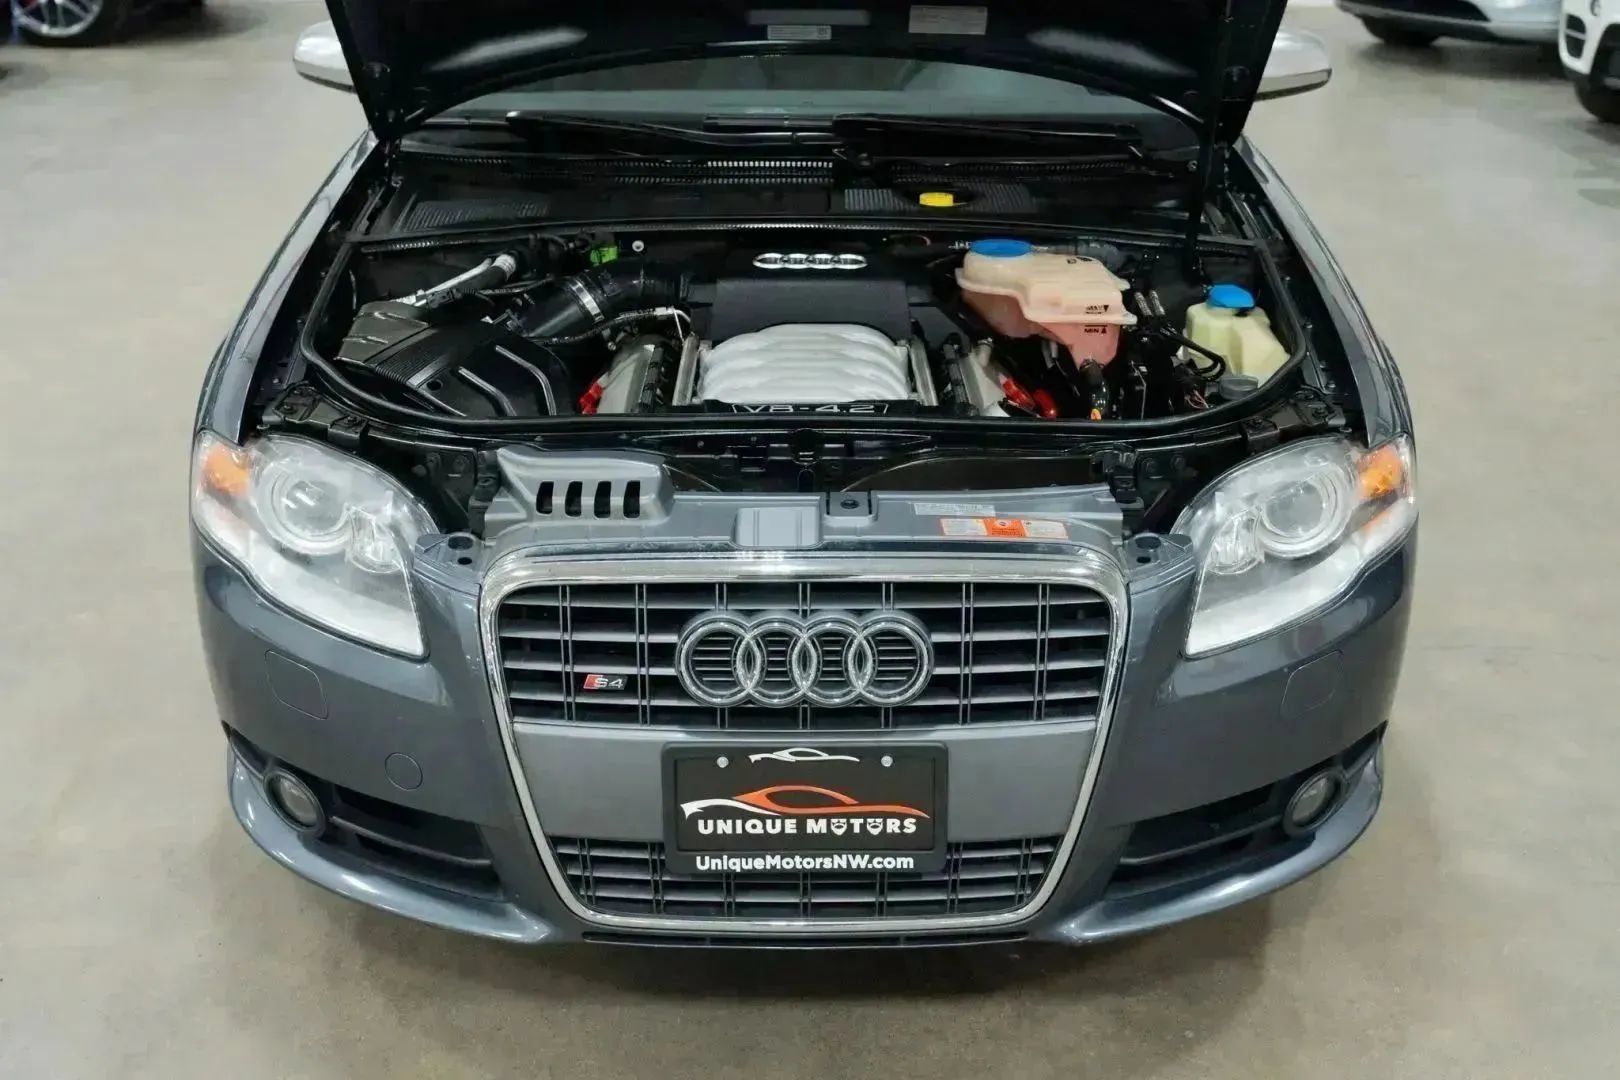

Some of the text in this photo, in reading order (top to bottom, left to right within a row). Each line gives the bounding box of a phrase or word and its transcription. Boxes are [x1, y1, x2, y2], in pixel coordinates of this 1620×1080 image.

[594, 677, 624, 688] S4
[697, 818, 917, 835] UNIQUE MOTORS
[696, 854, 914, 872] UniqueMotorsNW.com
